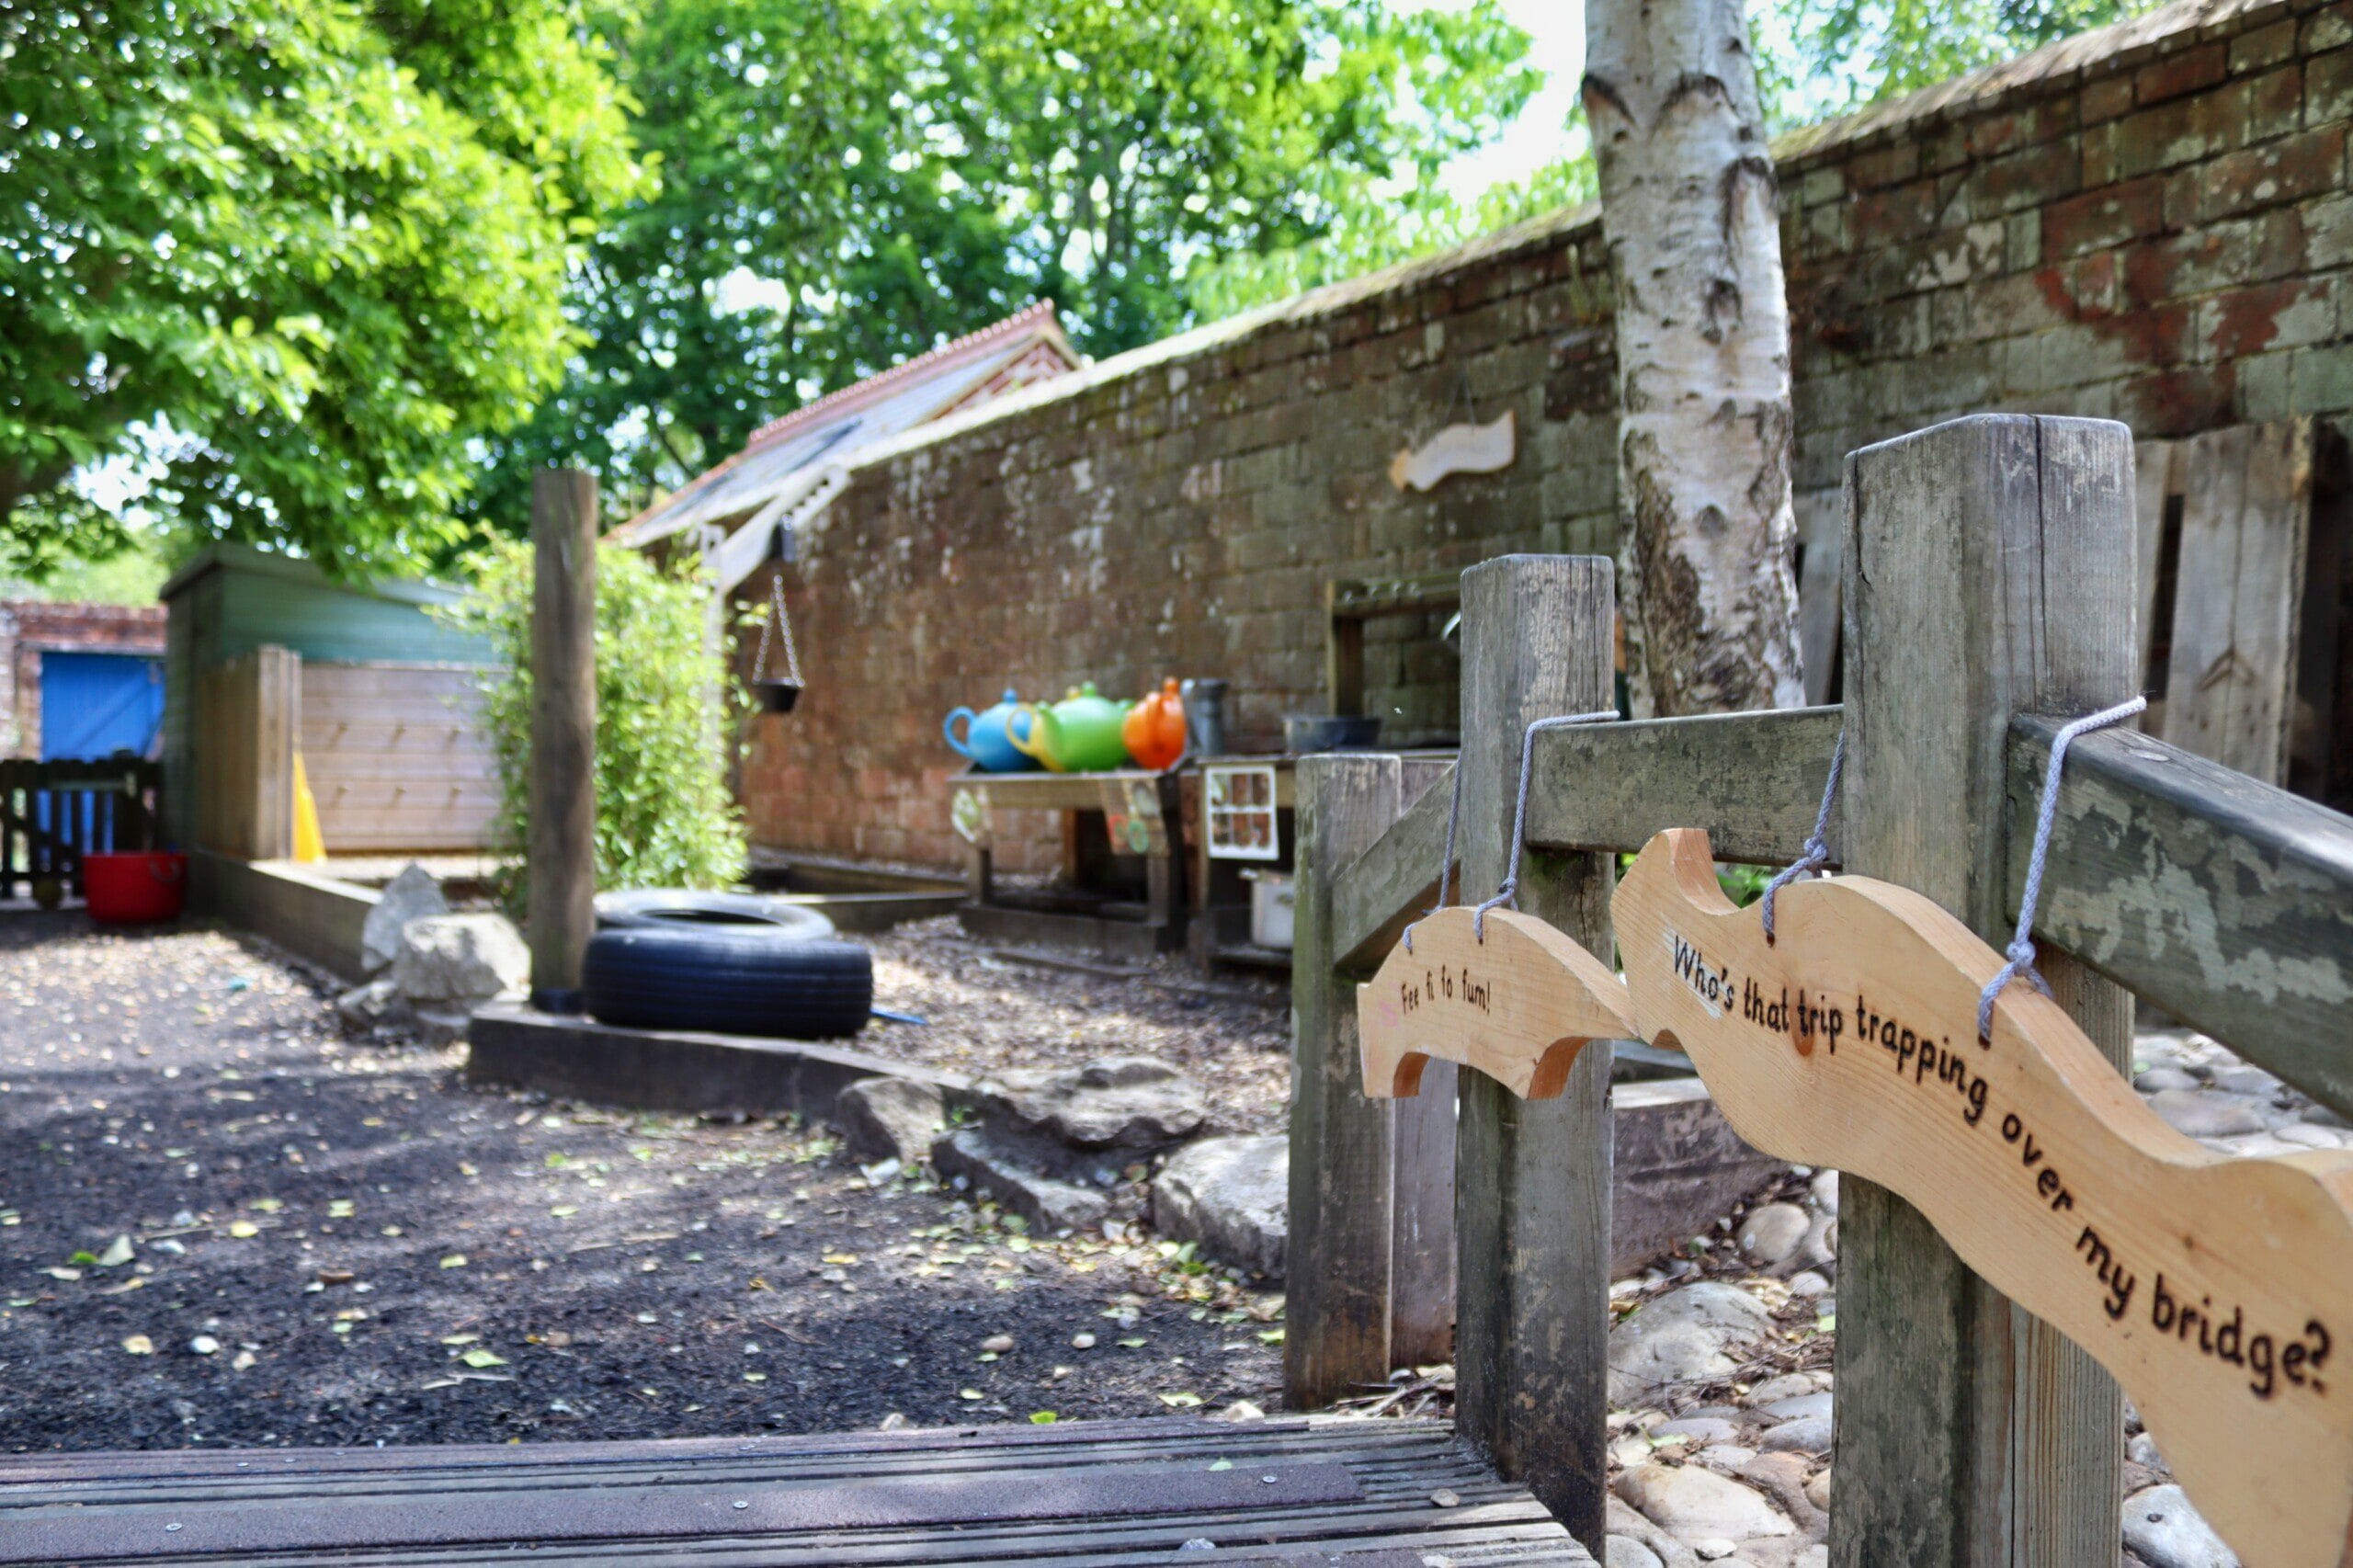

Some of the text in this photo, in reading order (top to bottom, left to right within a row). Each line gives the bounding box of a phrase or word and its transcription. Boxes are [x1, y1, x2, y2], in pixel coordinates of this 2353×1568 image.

[1402, 965, 1490, 1015] Fee fi fo fum!
[1674, 934, 2332, 1400] Who's that trip trapping over my bridge?
